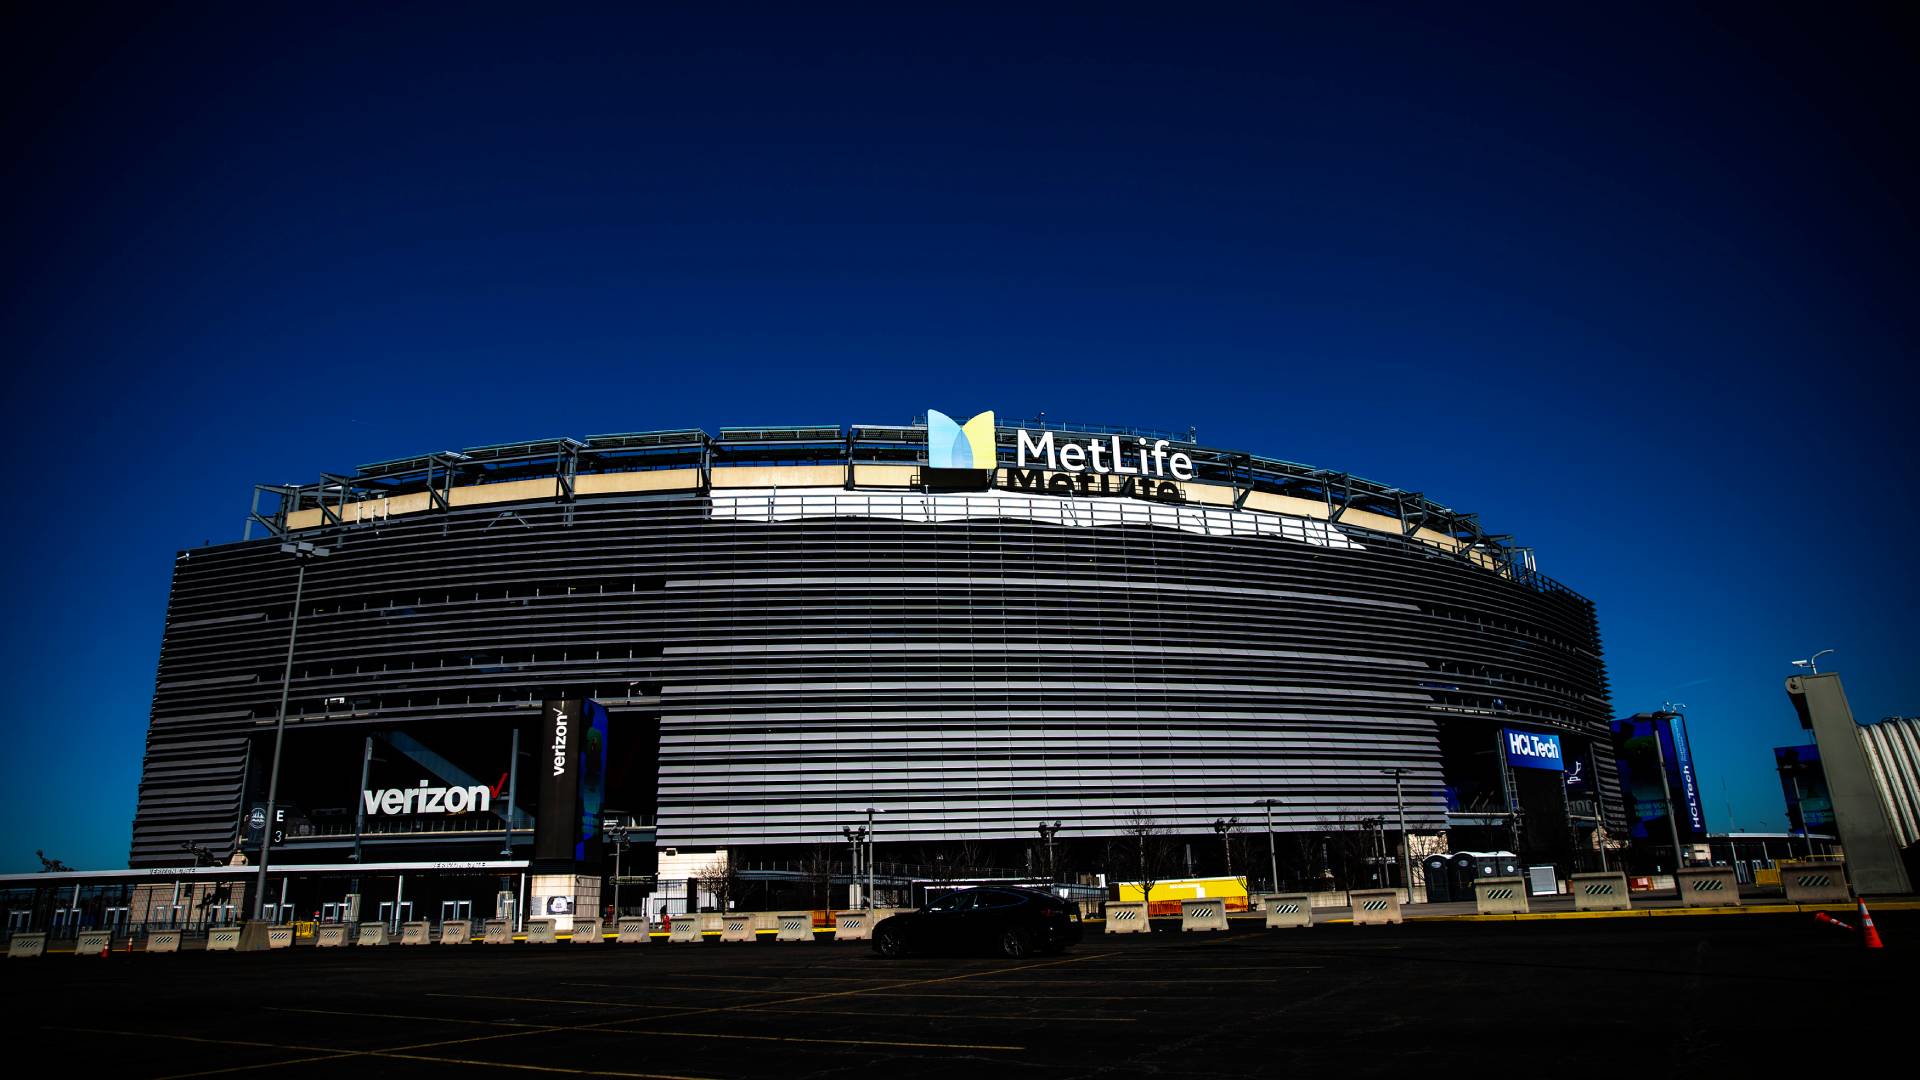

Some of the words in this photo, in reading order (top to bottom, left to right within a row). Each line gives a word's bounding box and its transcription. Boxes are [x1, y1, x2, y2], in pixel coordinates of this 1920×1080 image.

[1016, 429, 1193, 481] MetLife
[552, 715, 568, 776] verizon
[1508, 733, 1559, 758] HCLTech
[363, 779, 490, 815] verizon
[1683, 765, 1702, 828] HCLTech
[276, 809, 285, 822] E
[274, 830, 282, 843] 3
